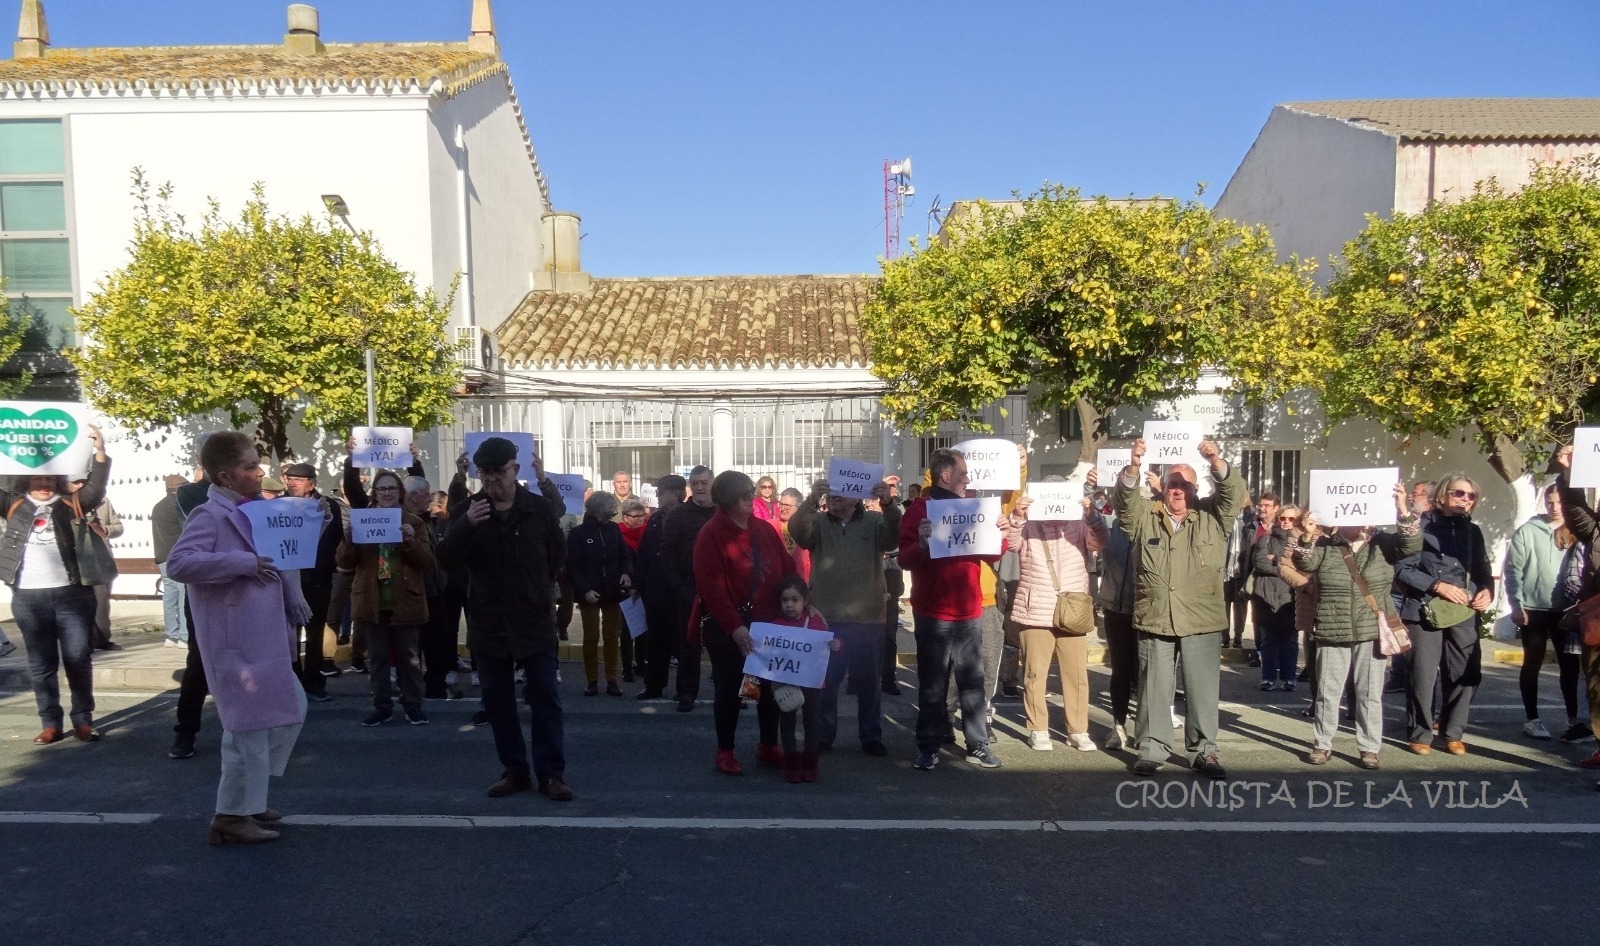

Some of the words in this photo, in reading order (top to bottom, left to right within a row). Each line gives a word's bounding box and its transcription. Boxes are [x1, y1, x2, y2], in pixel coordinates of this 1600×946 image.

[0, 418, 69, 430] ANIDAD
[364, 437, 399, 446] MÉDICO
[1153, 431, 1190, 441] MÉDICO
[9, 446, 37, 456] 100
[370, 451, 394, 462] ¡YA!
[1158, 446, 1183, 458] ¡YA!
[1105, 457, 1131, 467] MÉDIC
[839, 469, 871, 481] MÉDICO
[842, 483, 863, 493] ¡YA!
[1326, 482, 1377, 495] MÉDICO
[1044, 504, 1065, 516] ¡YA!
[1334, 503, 1368, 519] ¡YA!
[266, 513, 304, 528] MÉDICO
[360, 517, 390, 525] MÉDICO
[942, 512, 986, 526] MÉDICO
[366, 528, 386, 539] ¡YA!
[947, 531, 977, 549] ¡YA!
[280, 539, 299, 560] ¡YA!
[763, 636, 813, 653] MÉDICO
[767, 656, 801, 674] ¡YA!
